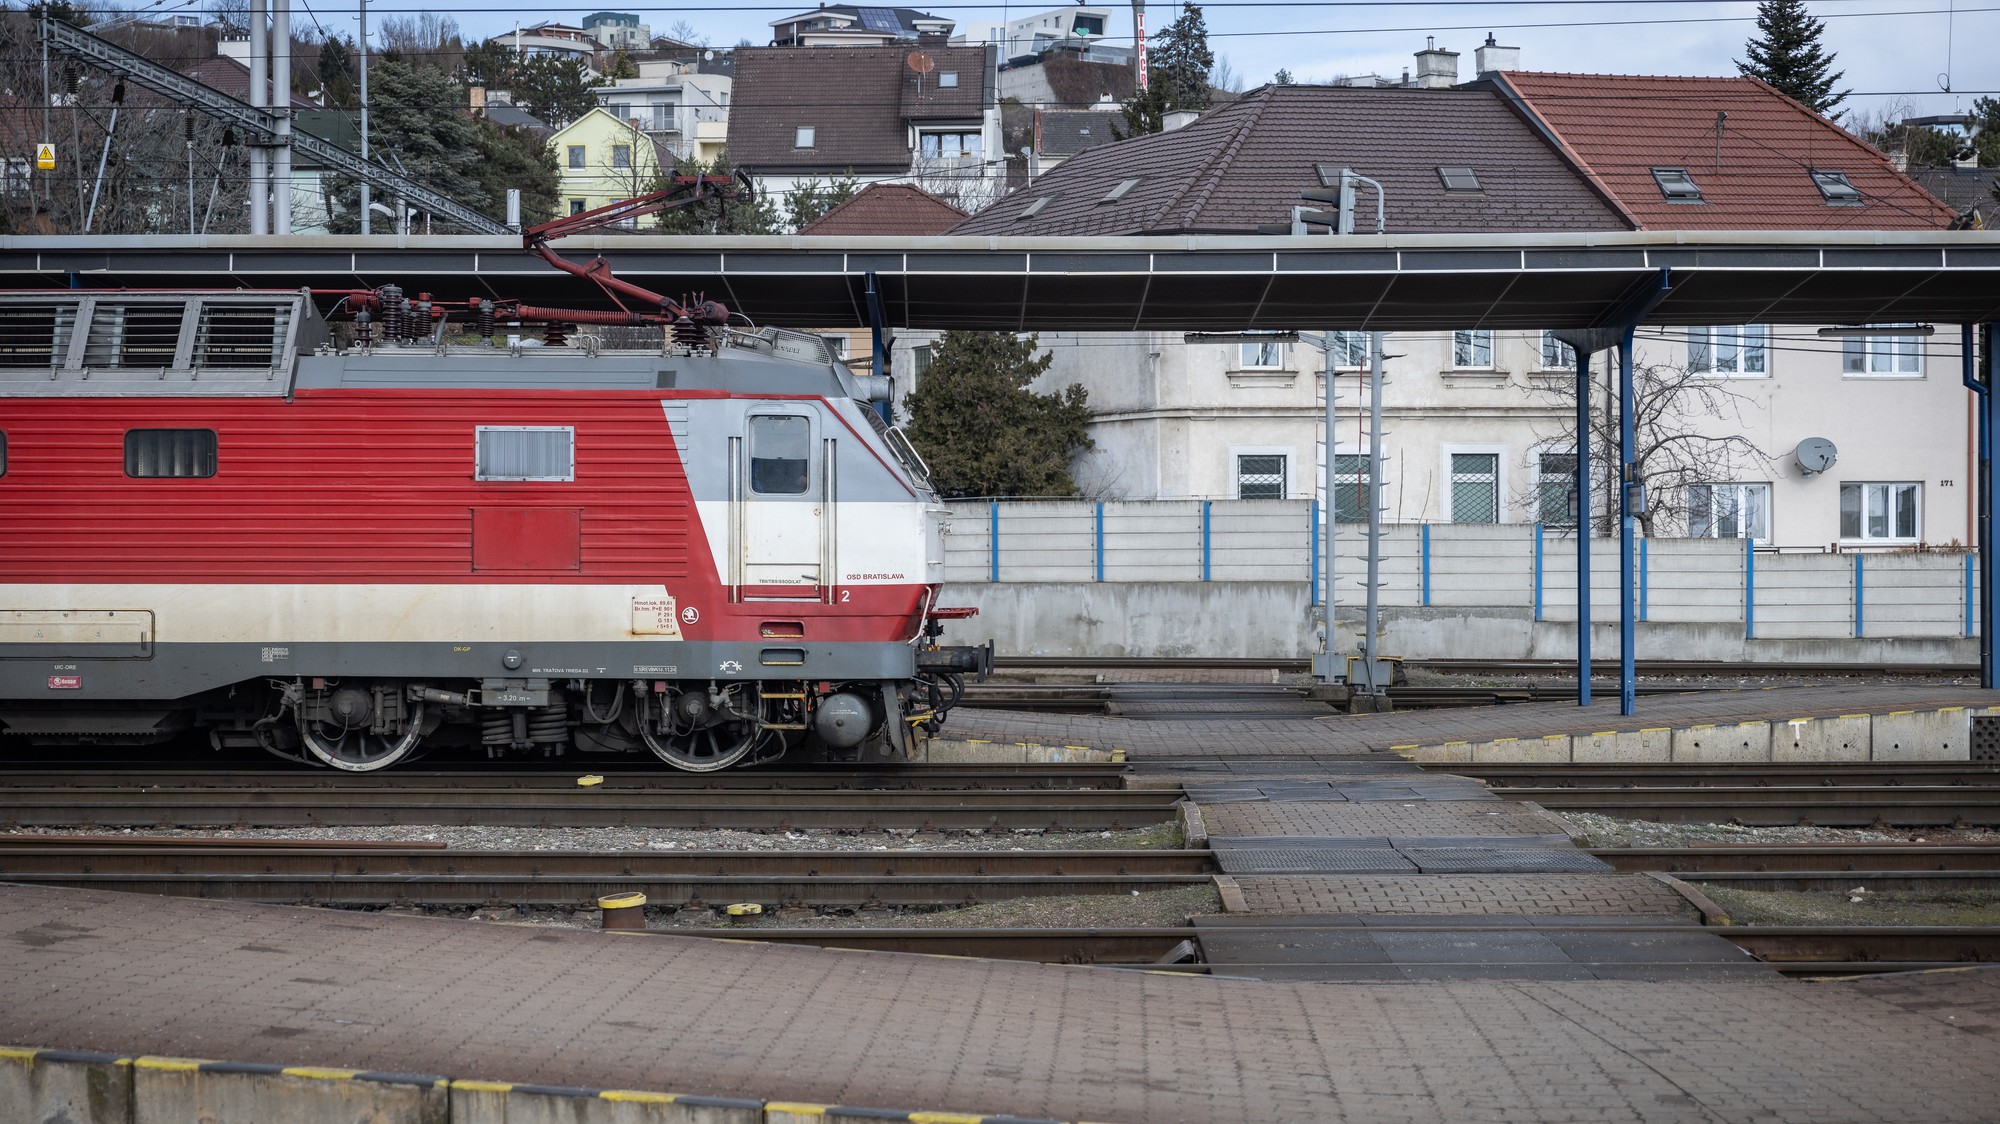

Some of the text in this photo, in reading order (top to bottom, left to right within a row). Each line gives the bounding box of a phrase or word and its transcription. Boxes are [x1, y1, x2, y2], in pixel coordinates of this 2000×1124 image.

[846, 573, 905, 581] OSD BRATISLAVA
[841, 590, 850, 603] 2
